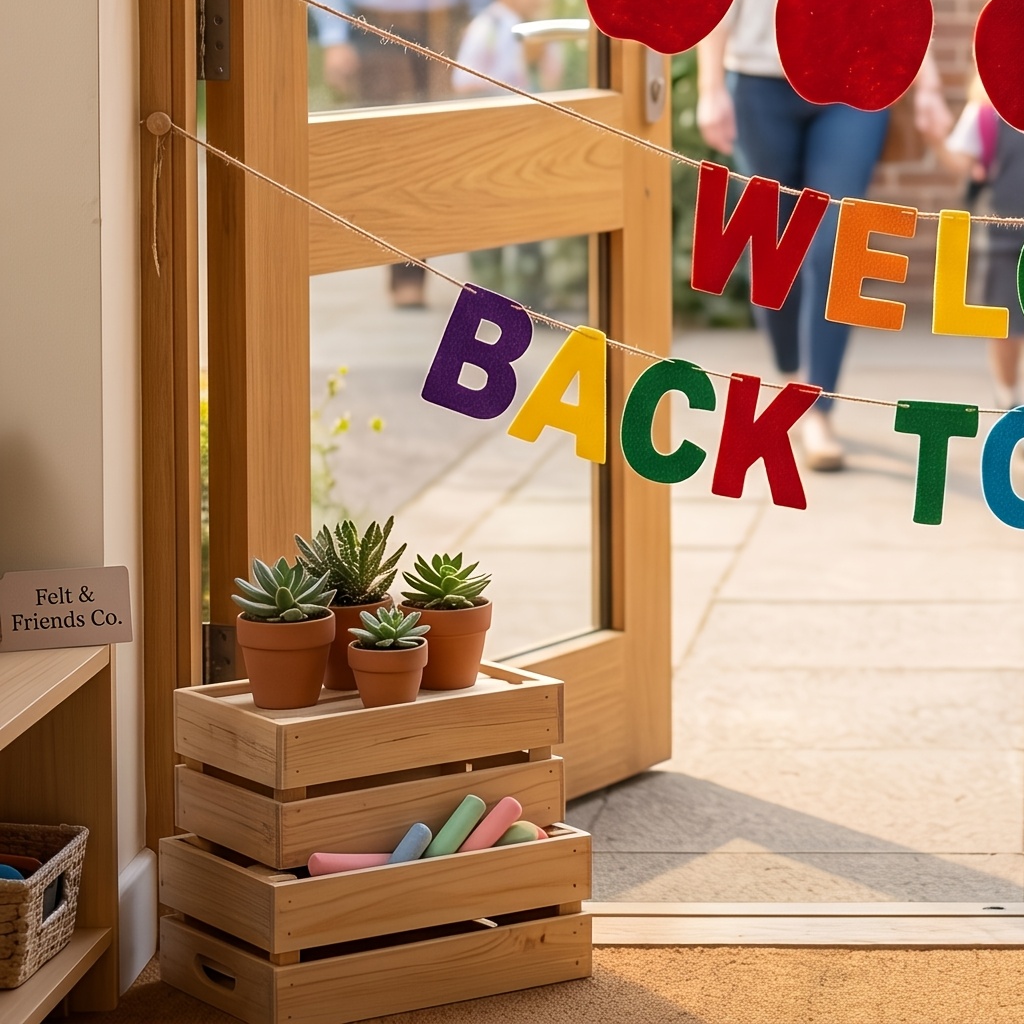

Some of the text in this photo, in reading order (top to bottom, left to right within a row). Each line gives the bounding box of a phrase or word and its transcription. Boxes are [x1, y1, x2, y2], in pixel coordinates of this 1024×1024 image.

[420, 282, 823, 511] BACK
[35, 585, 95, 606] Felt &
[11, 608, 122, 632] Friends Co.
